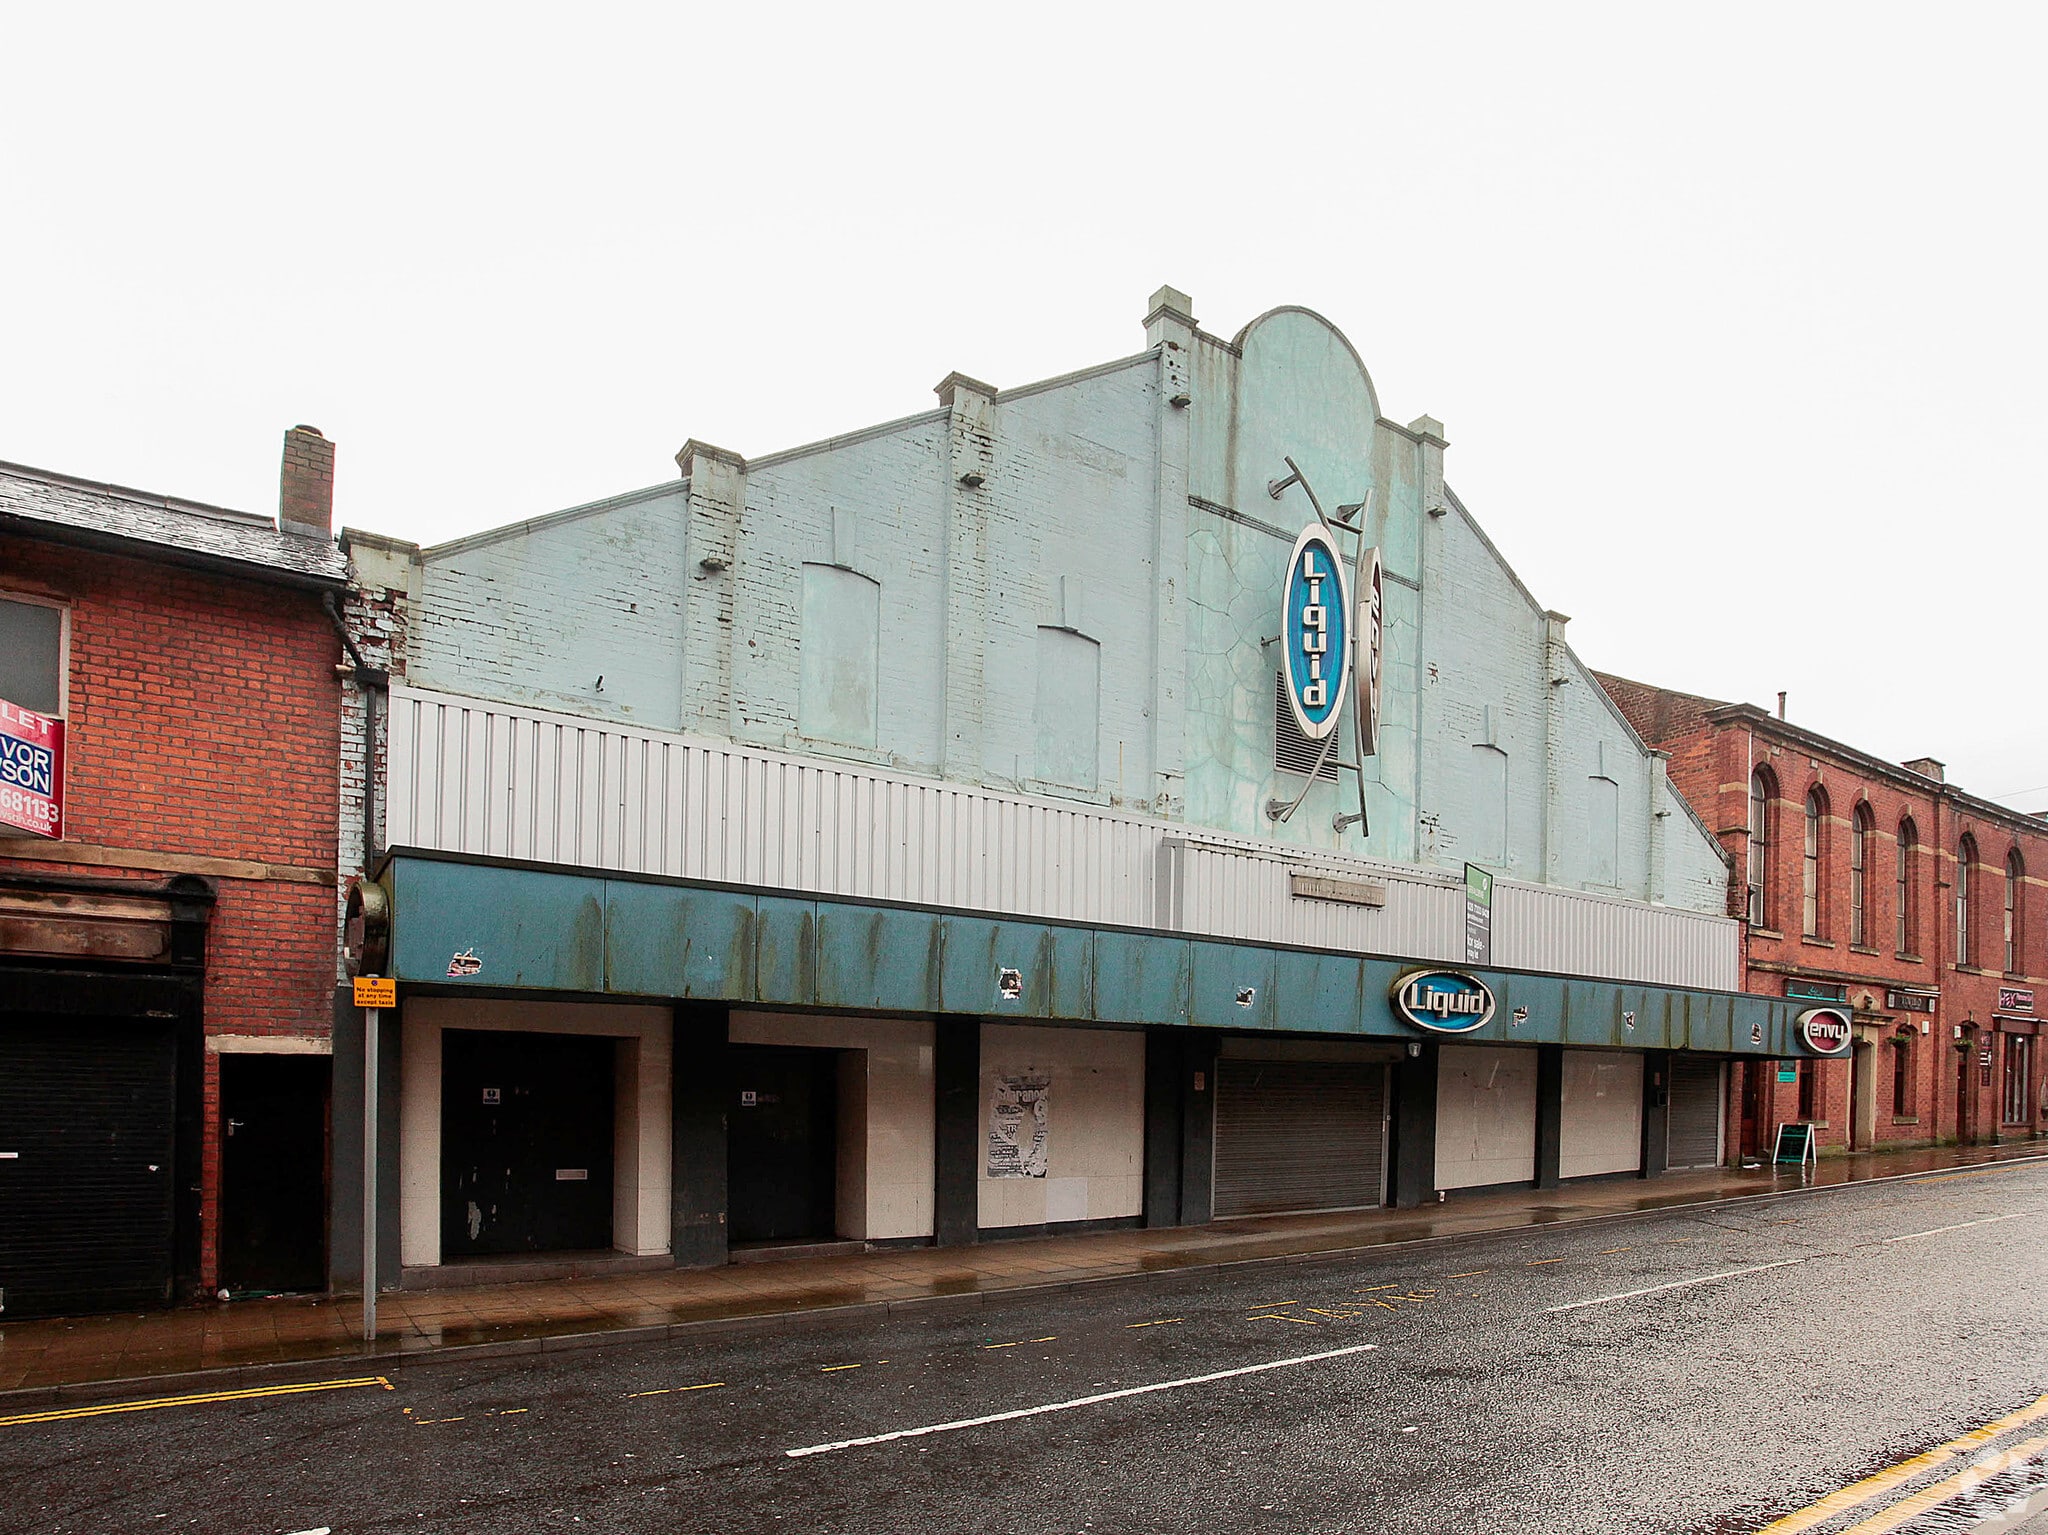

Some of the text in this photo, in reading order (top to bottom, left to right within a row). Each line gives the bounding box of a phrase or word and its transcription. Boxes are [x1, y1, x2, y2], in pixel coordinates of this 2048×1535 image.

[1303, 551, 1327, 706] Liquid
[2, 703, 53, 735] LET
[1, 736, 49, 772] VOR
[0, 787, 59, 823] 681133
[1408, 983, 1485, 1018] Liquid
[1809, 1022, 1845, 1042] envy
